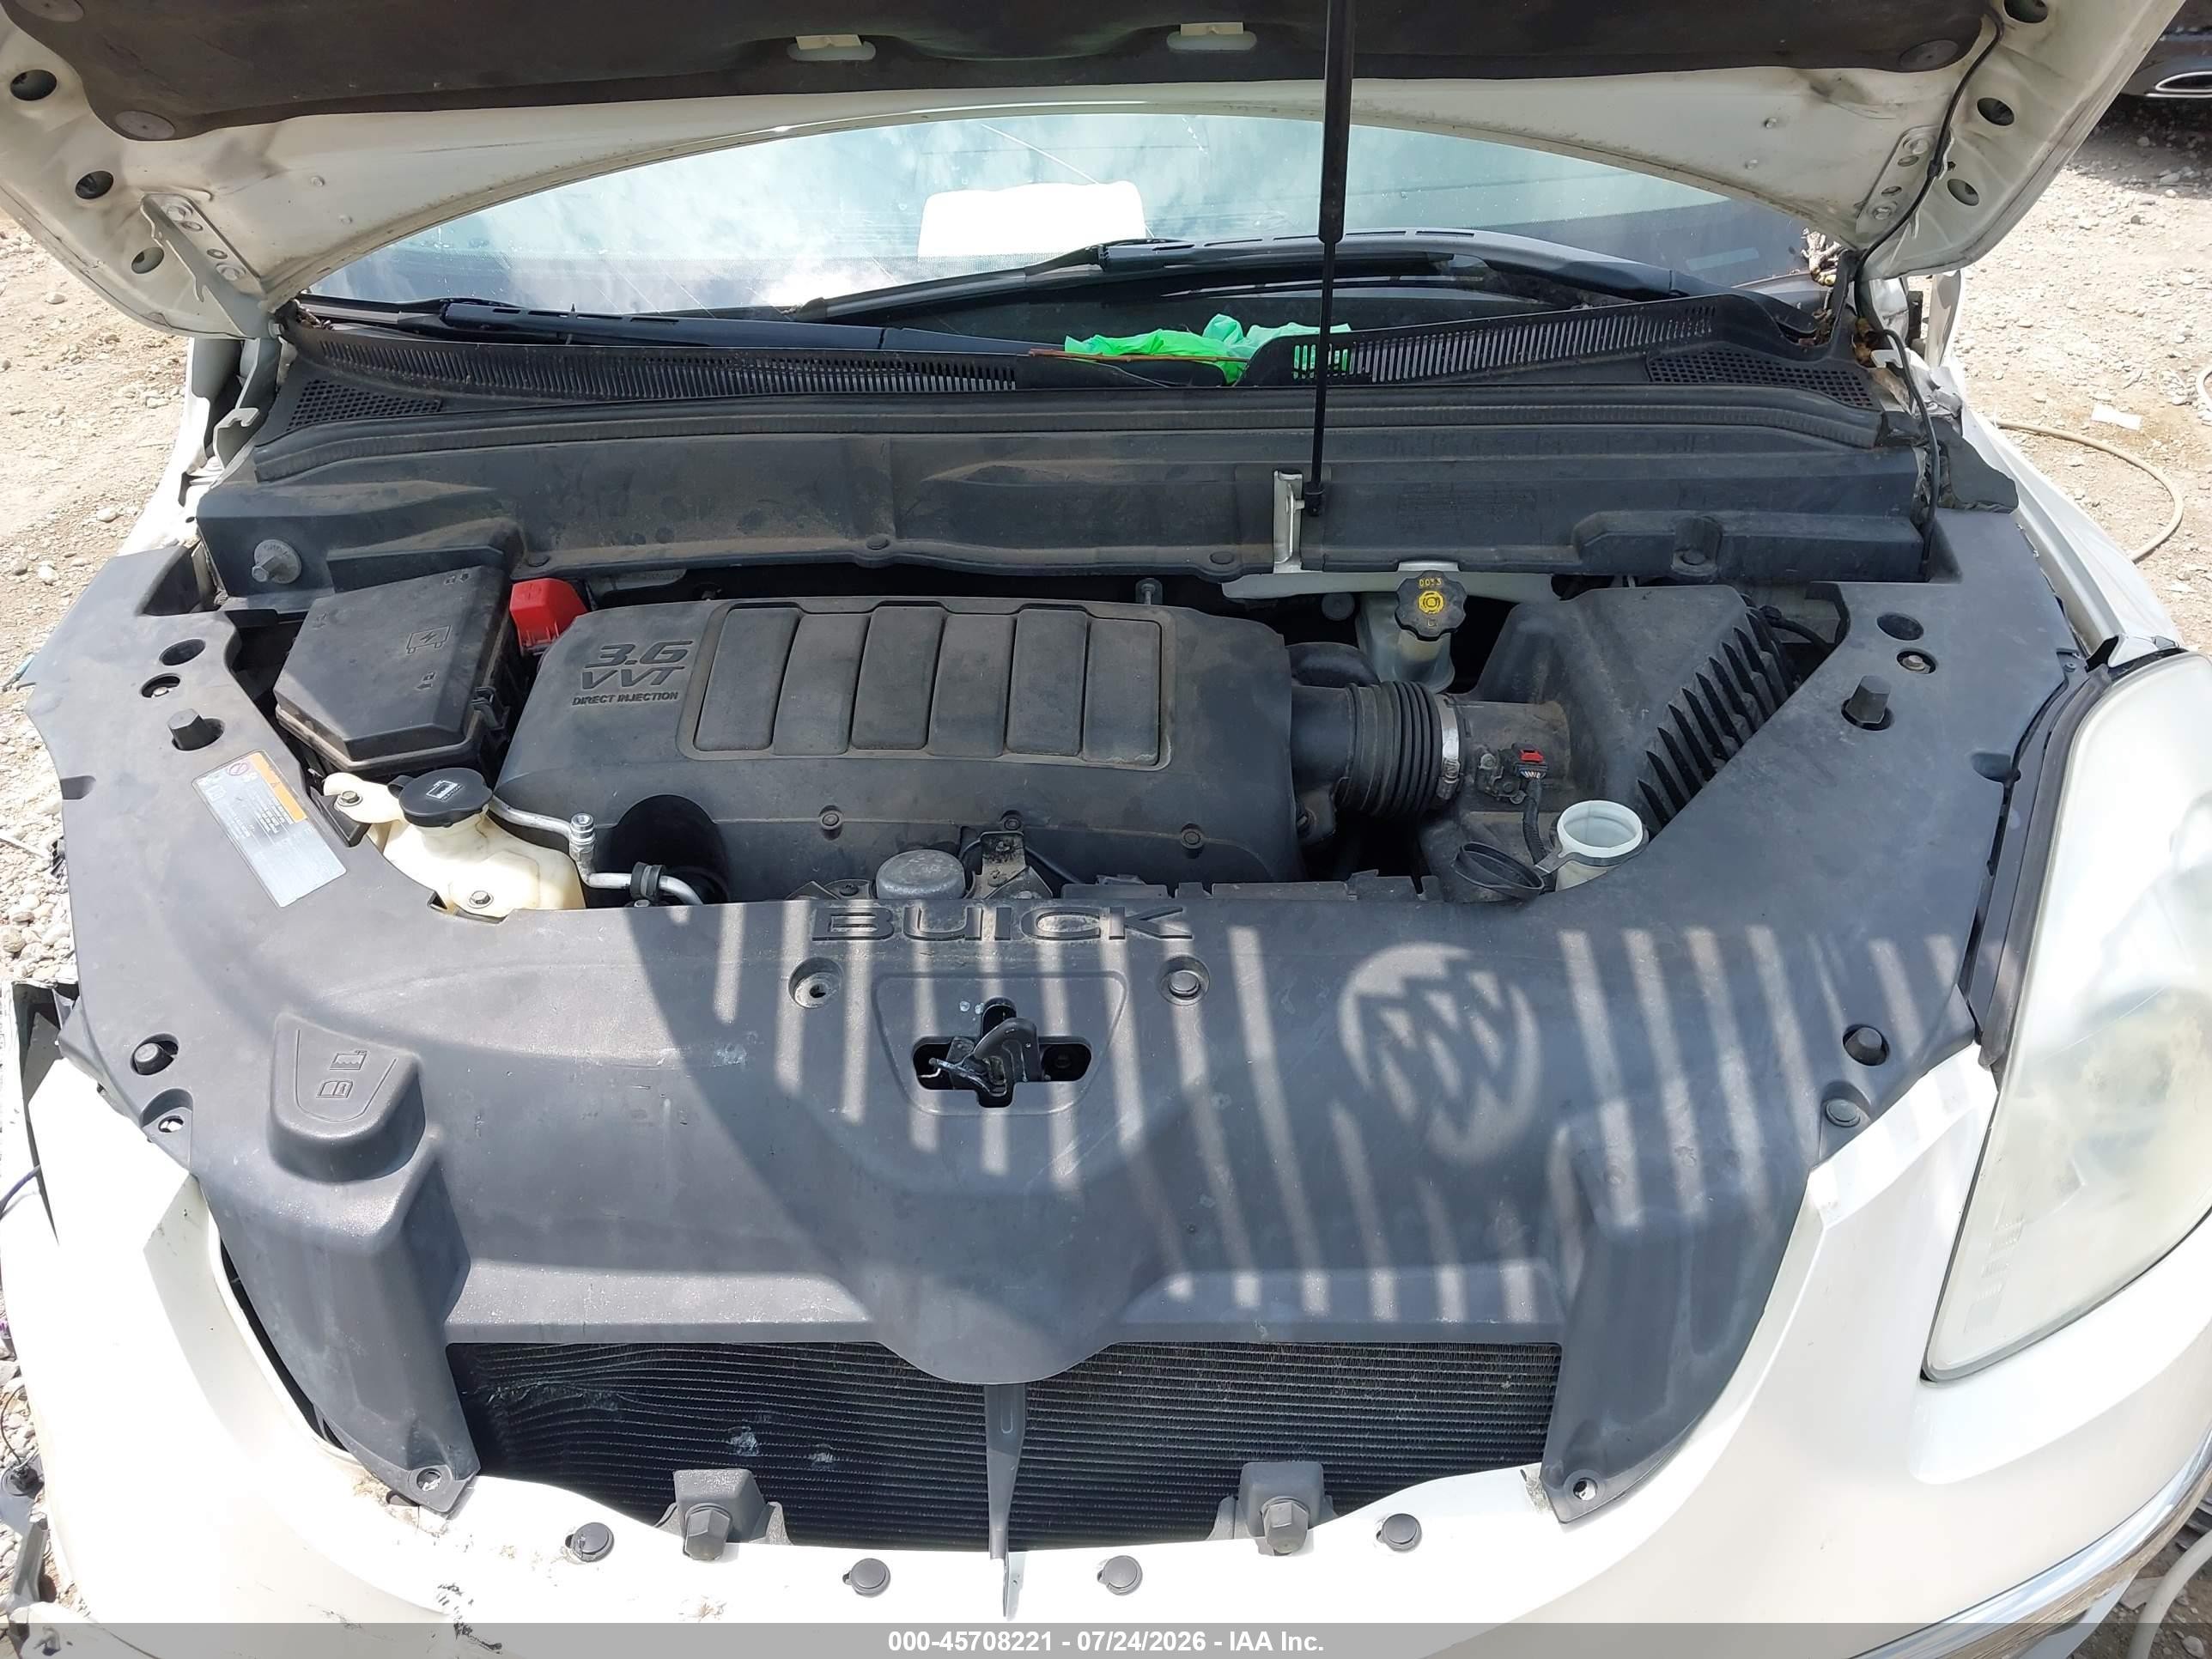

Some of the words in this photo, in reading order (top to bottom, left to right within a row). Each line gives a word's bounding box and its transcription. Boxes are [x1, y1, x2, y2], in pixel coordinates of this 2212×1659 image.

[584, 640, 694, 669] 3.6
[581, 665, 685, 690] VVT
[571, 694, 615, 706] DIRECT
[617, 691, 678, 702] INJECTION
[811, 906, 1194, 941] BUICK
